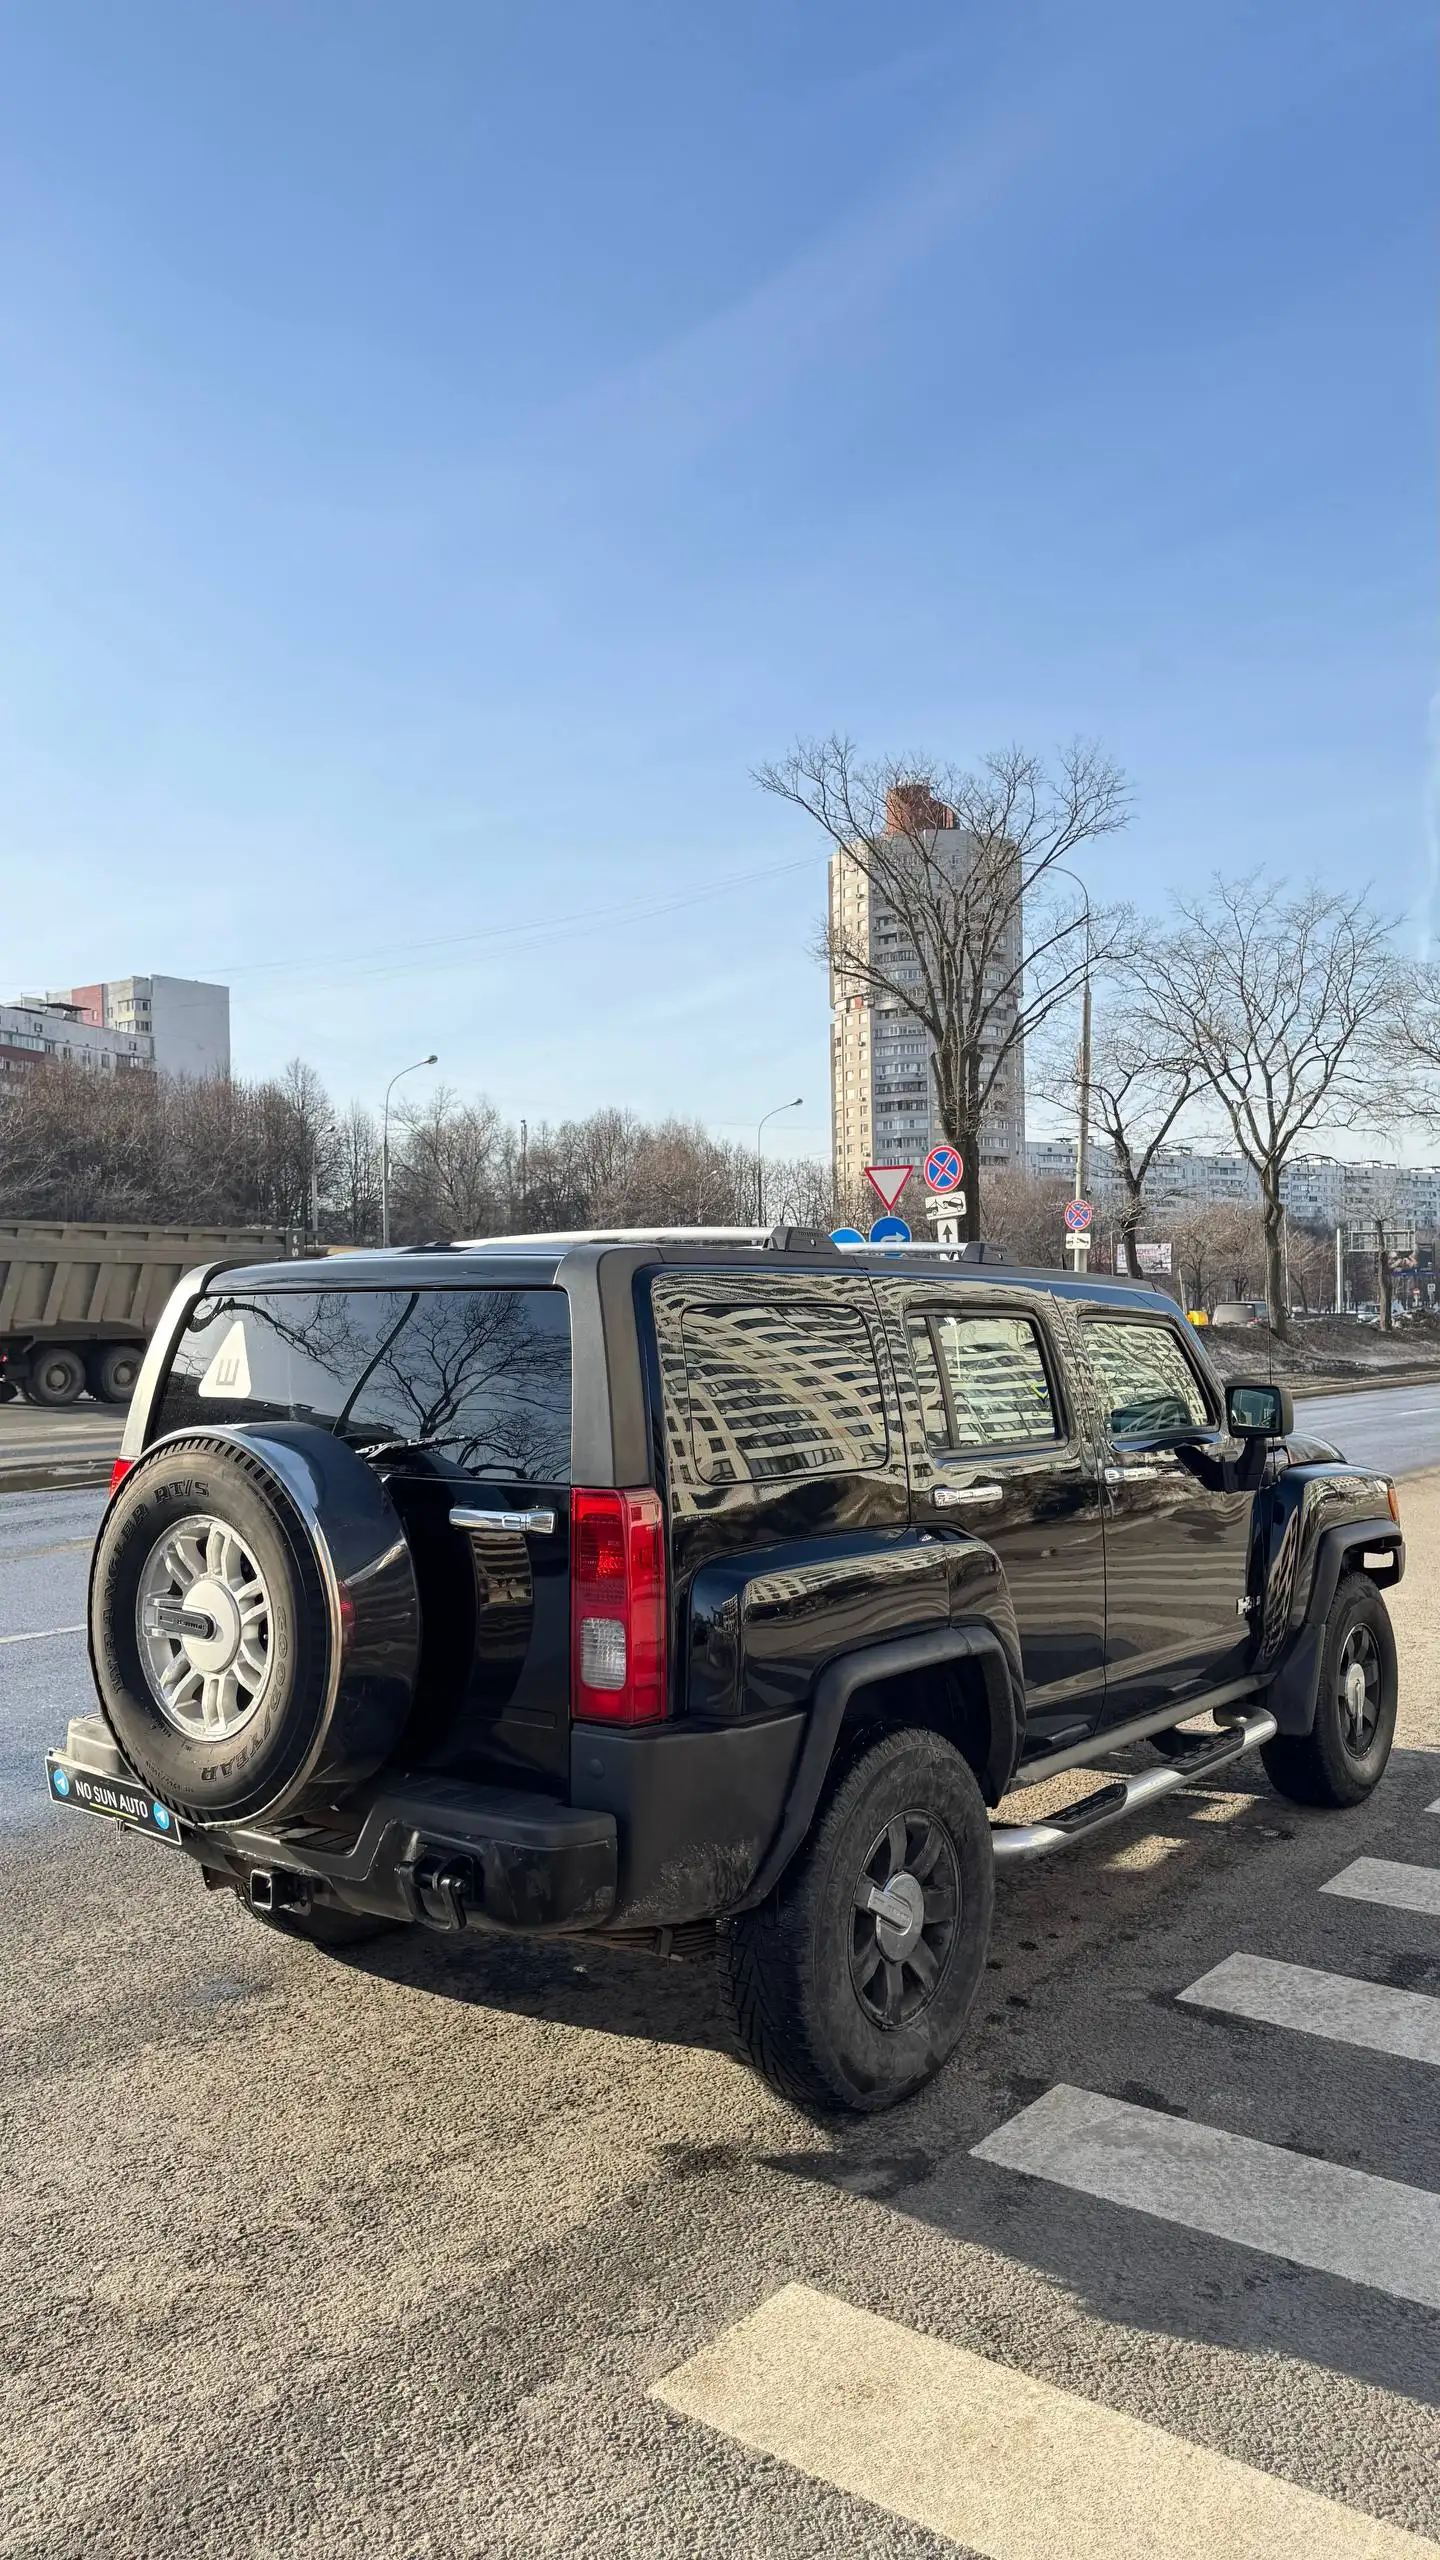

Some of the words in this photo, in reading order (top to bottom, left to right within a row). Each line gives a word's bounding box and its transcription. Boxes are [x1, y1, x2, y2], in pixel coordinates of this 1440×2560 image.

[215, 1358, 240, 1386] Ш
[75, 1780, 92, 1800] NO
[93, 1785, 117, 1808] SUN
[120, 1793, 148, 1818] AUTO
